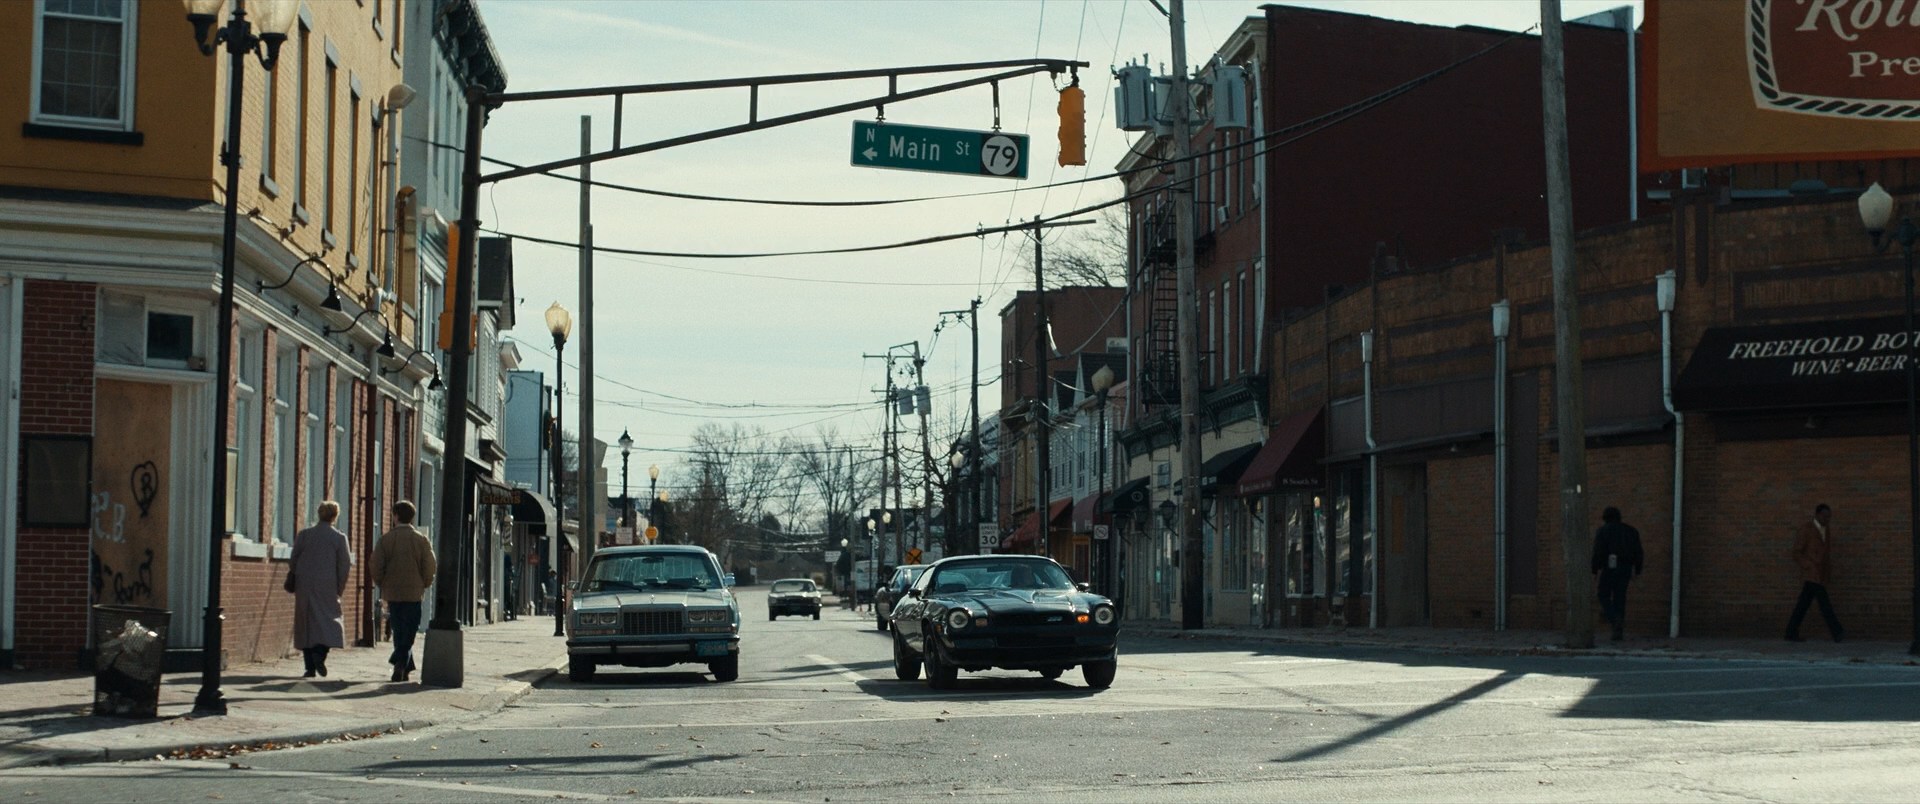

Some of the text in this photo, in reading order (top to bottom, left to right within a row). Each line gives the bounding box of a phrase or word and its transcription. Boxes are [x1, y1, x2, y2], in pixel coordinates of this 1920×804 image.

[1848, 51, 1920, 78] Pre
[866, 128, 875, 143] N
[889, 135, 970, 161] Main St
[986, 145, 1016, 168] 79
[1728, 335, 1864, 359] FREEHOLD
[1791, 358, 1845, 376] WINE
[982, 535, 997, 545] 30
